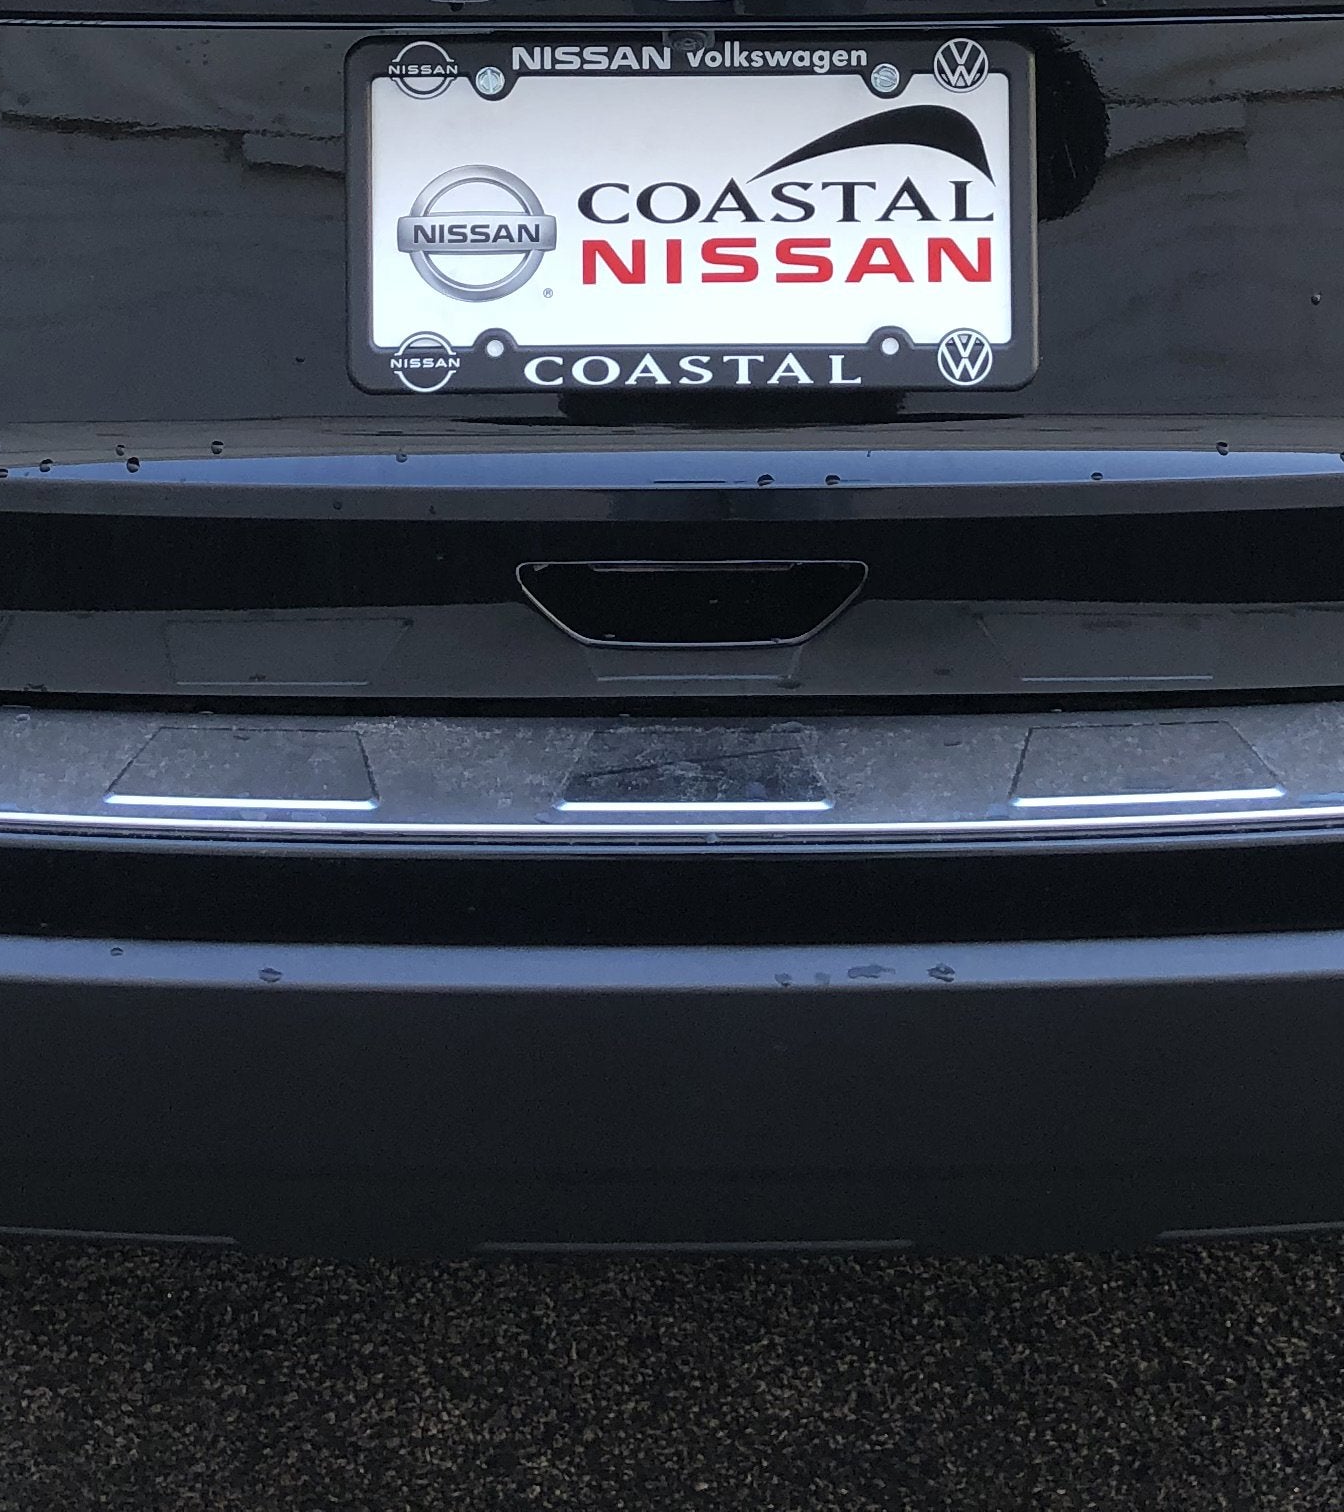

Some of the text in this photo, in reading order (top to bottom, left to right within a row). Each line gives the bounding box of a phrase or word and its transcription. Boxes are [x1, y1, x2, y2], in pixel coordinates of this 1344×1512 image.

[388, 64, 458, 76] NISSAN
[512, 41, 868, 73] NISSAN volkswagen
[577, 177, 994, 225] COASTAL
[413, 223, 541, 245] NISSAN
[582, 236, 993, 285] NISSAN
[390, 357, 460, 369] NISSAN
[524, 353, 862, 386] COASTAL
